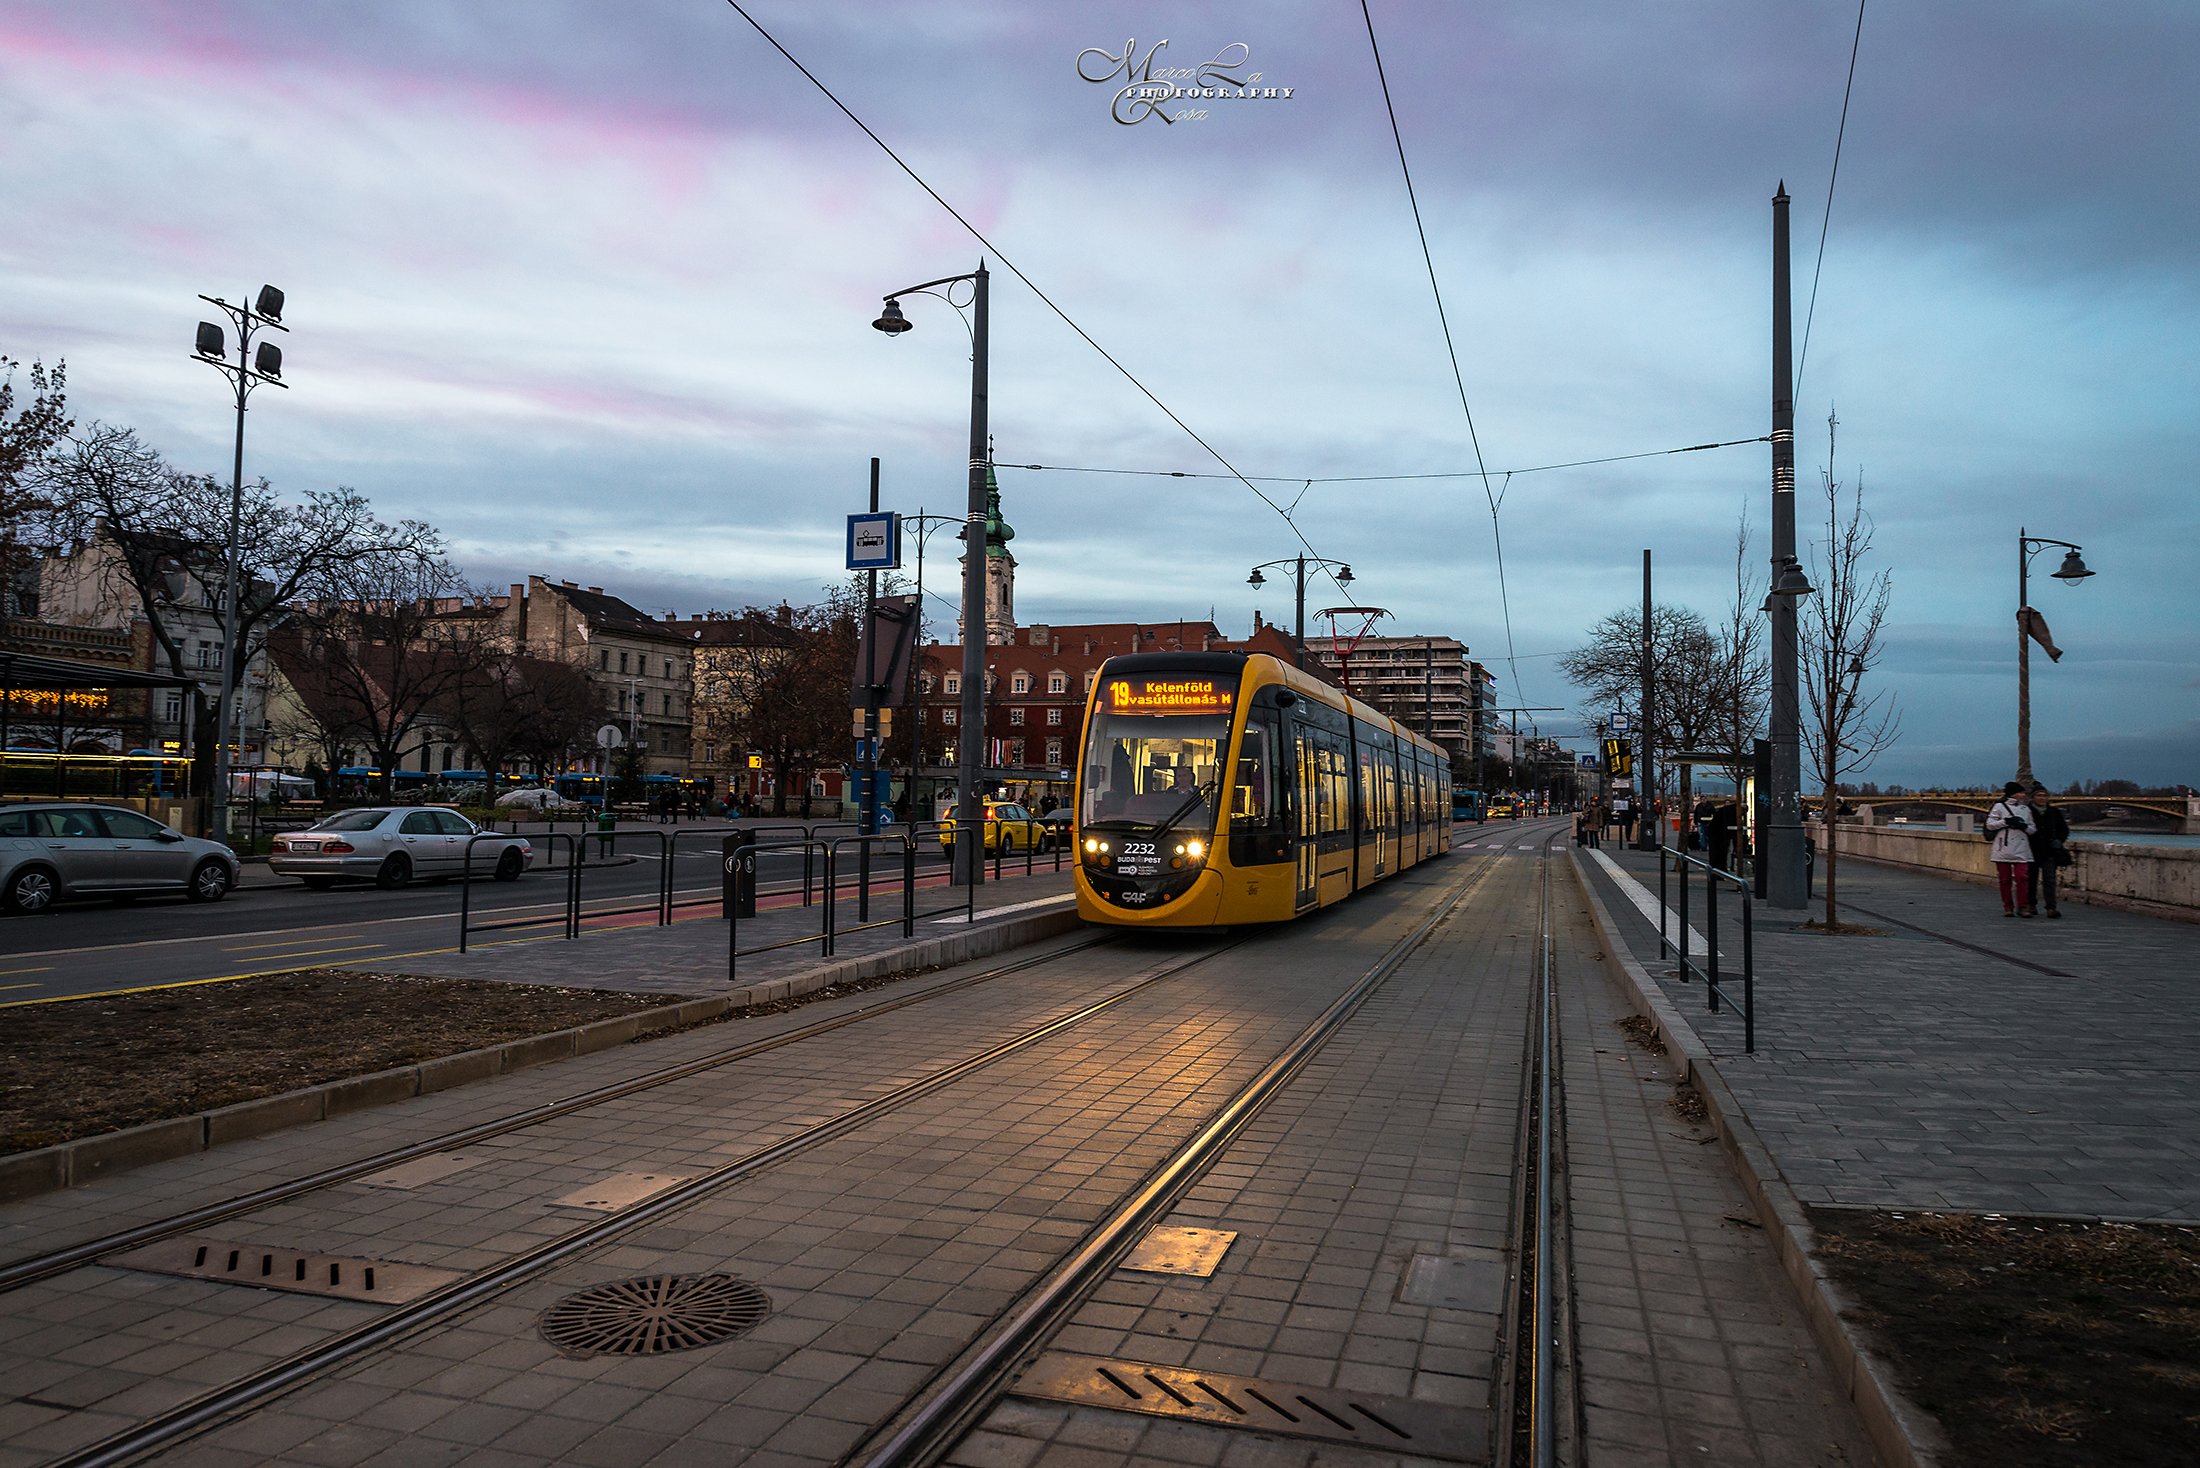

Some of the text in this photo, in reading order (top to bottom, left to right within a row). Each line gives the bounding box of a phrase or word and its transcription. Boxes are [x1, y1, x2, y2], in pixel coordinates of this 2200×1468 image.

[1109, 681, 1130, 706] 19
[1146, 682, 1213, 693] Kelenföld
[1129, 693, 1231, 705] vasútállomás M
[1124, 843, 1155, 855] 2232
[1122, 891, 1146, 903] CAF
